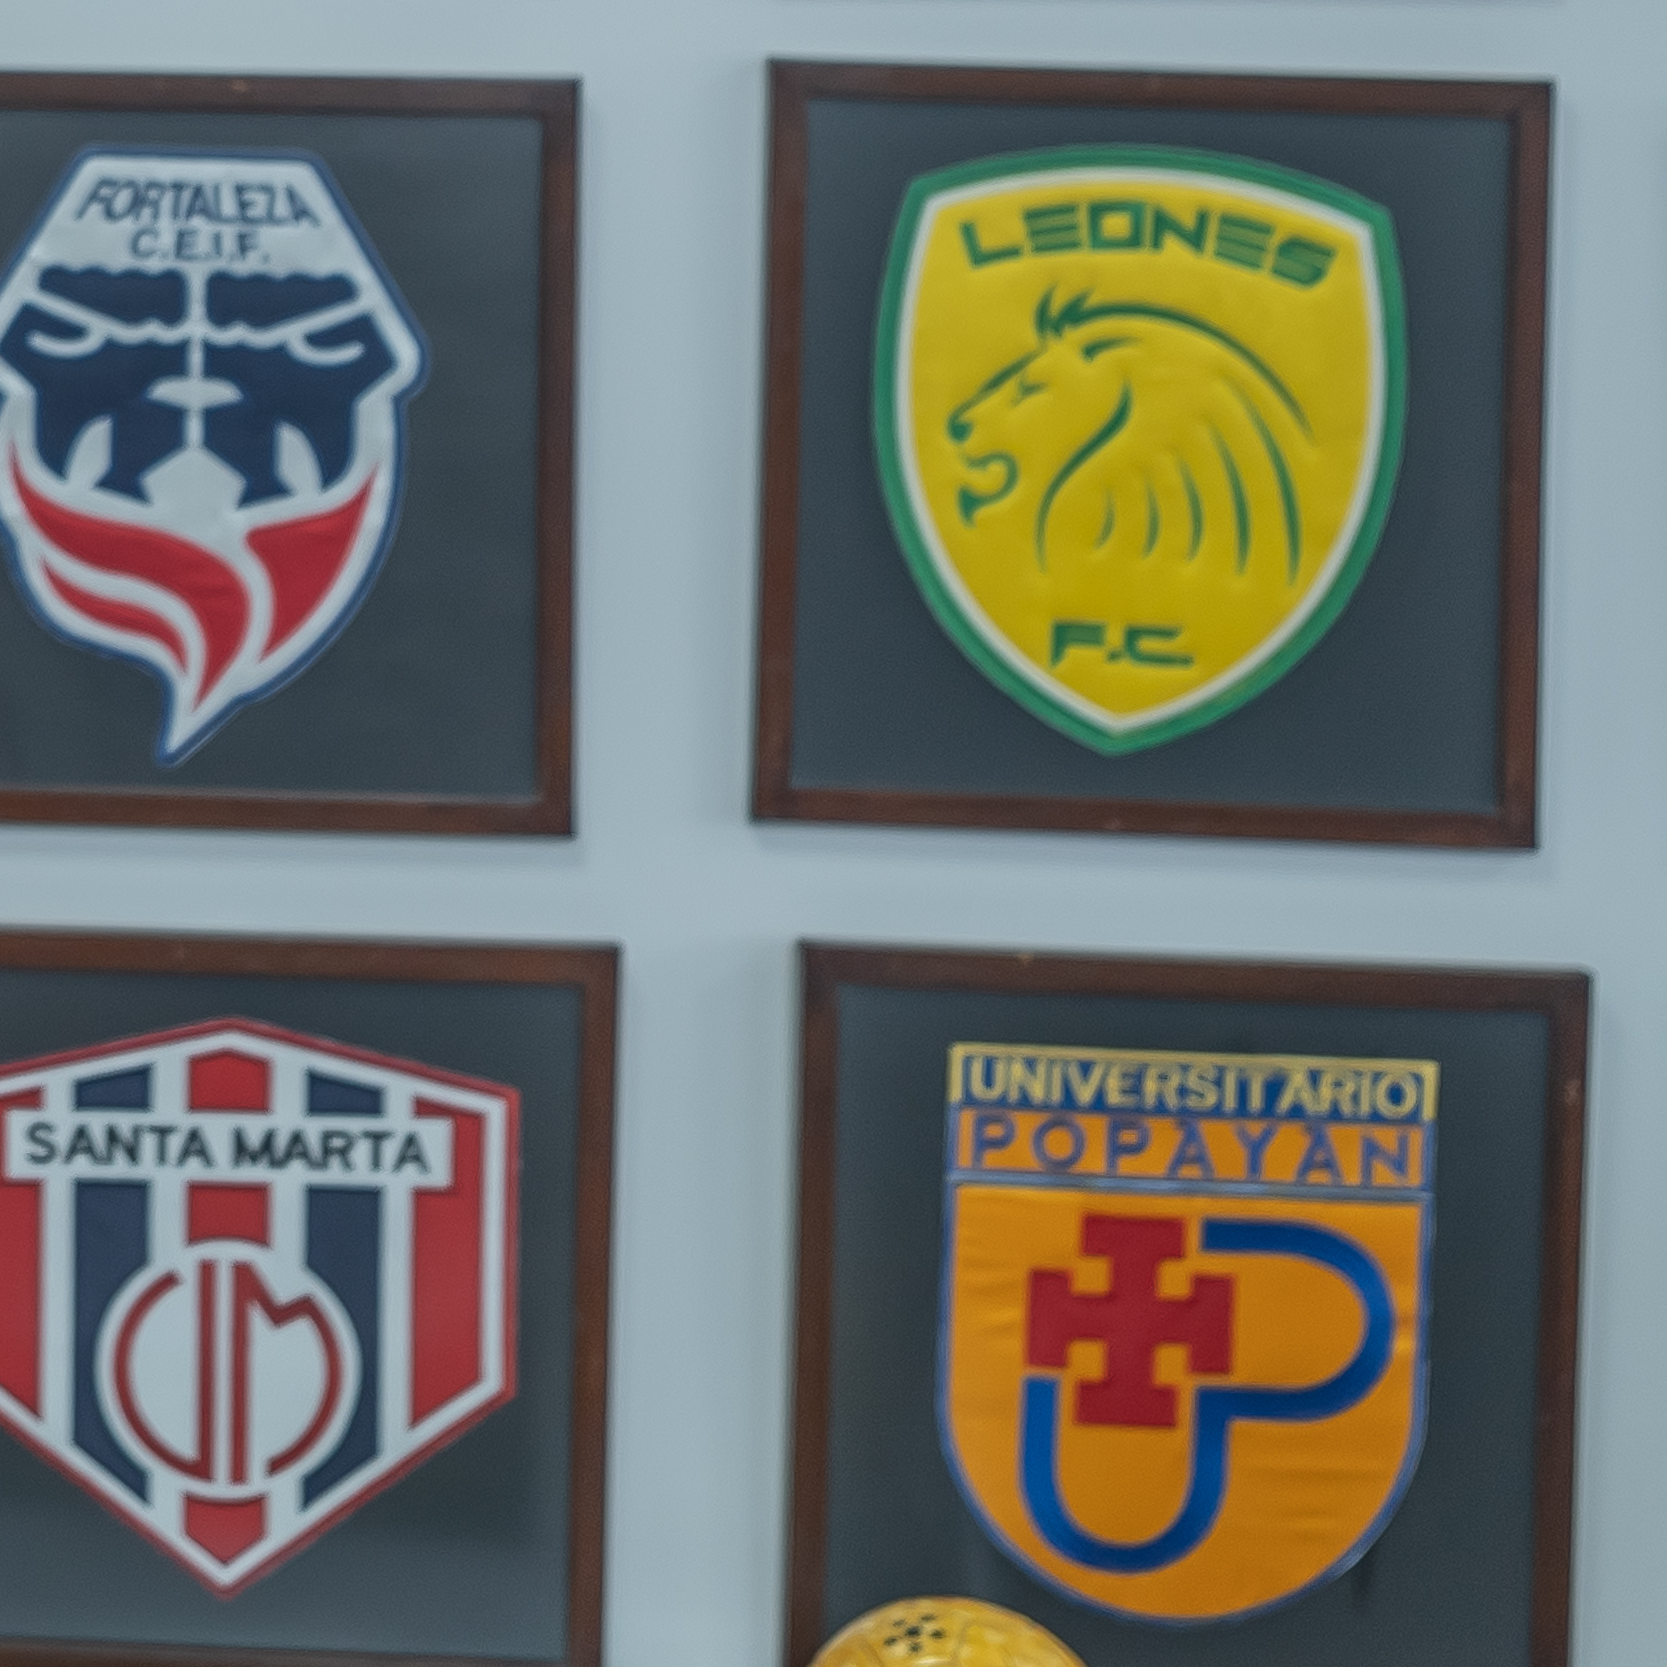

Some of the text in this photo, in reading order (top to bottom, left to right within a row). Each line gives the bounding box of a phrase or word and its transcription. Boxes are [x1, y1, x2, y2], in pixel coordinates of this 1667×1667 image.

[960, 199, 1338, 289] LEONES
[969, 1052, 1419, 1118] UNIVERSITARIO
[25, 1120, 433, 1177] SANTA MARTA
